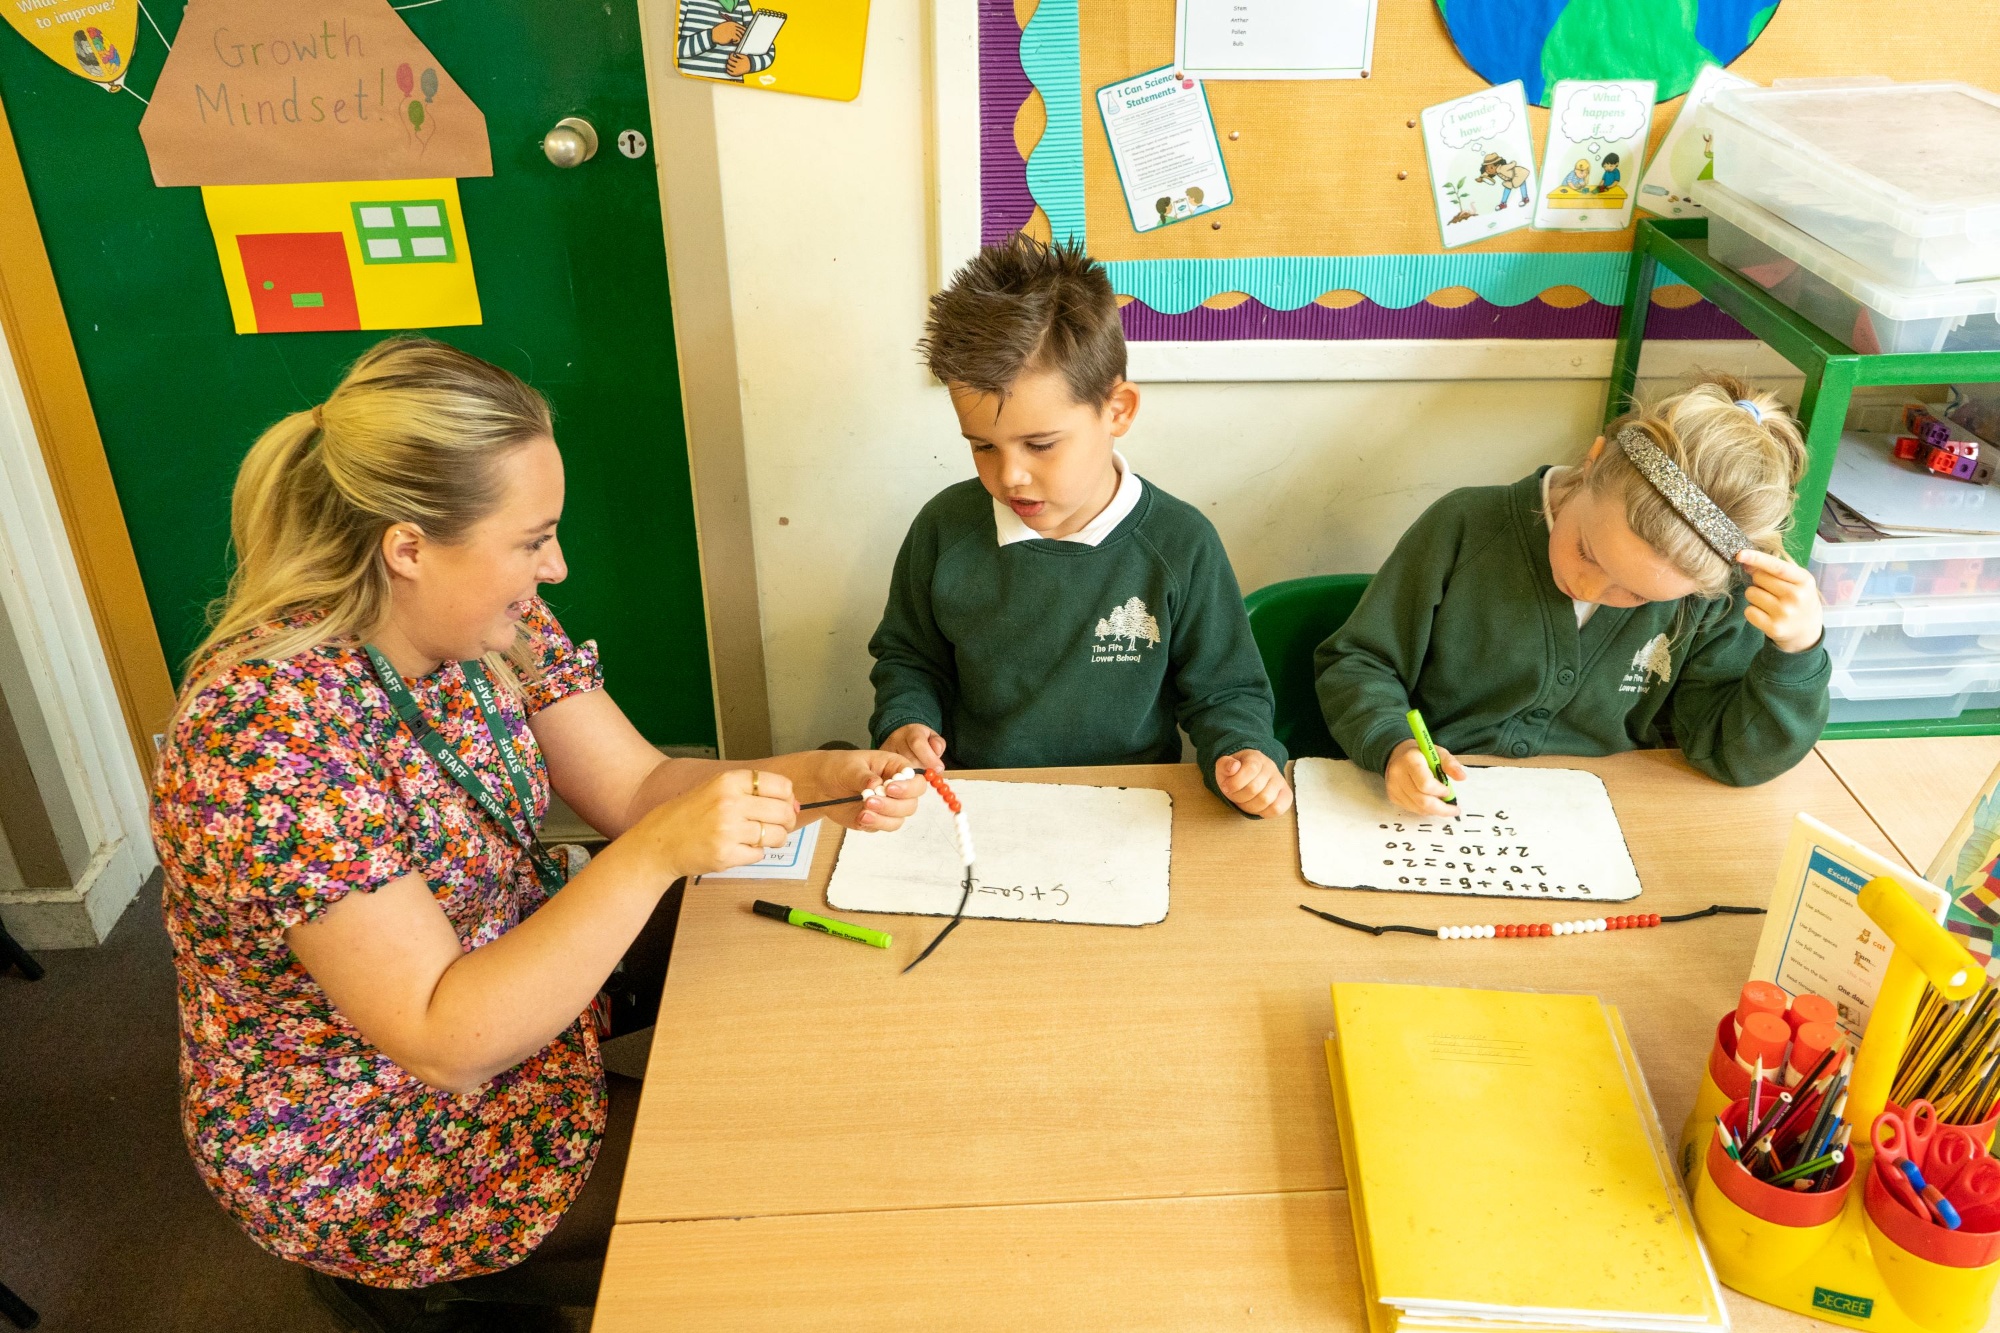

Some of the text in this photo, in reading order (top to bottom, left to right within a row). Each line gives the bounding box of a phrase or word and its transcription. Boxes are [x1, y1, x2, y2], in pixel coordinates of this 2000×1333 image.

[35, 0, 116, 29] to improve?
[213, 17, 365, 68] Growth
[1117, 73, 1175, 98] I Can Scienc
[195, 68, 385, 126] Mindset!
[1126, 87, 1176, 109] Statements
[1593, 92, 1621, 102] What
[1457, 103, 1497, 122] wonder
[1582, 107, 1626, 119] happens
[1091, 645, 1106, 653] The
[1091, 654, 1141, 663] Lower School
[375, 655, 402, 693] STAFF
[473, 677, 497, 715] STAFF
[499, 738, 521, 774] STAFF
[437, 748, 469, 779] STAFF
[479, 791, 506, 820] STAFF
[1417, 823, 1433, 833] =
[1442, 824, 1454, 836] 5
[1491, 825, 1517, 837] 25
[1430, 843, 1445, 853] =
[1459, 844, 1486, 857] 10
[1515, 845, 1529, 858] 2
[1439, 877, 1451, 886] =
[1578, 884, 1592, 895] 5
[1820, 886, 1838, 901] capital
[1838, 896, 1853, 908] letters
[1808, 926, 1823, 941] finger
[1823, 935, 1838, 949] spaces
[1872, 940, 1887, 952] cat
[1790, 956, 1804, 968] Write
[1812, 949, 1826, 962] stops
[1837, 984, 1851, 997] One
